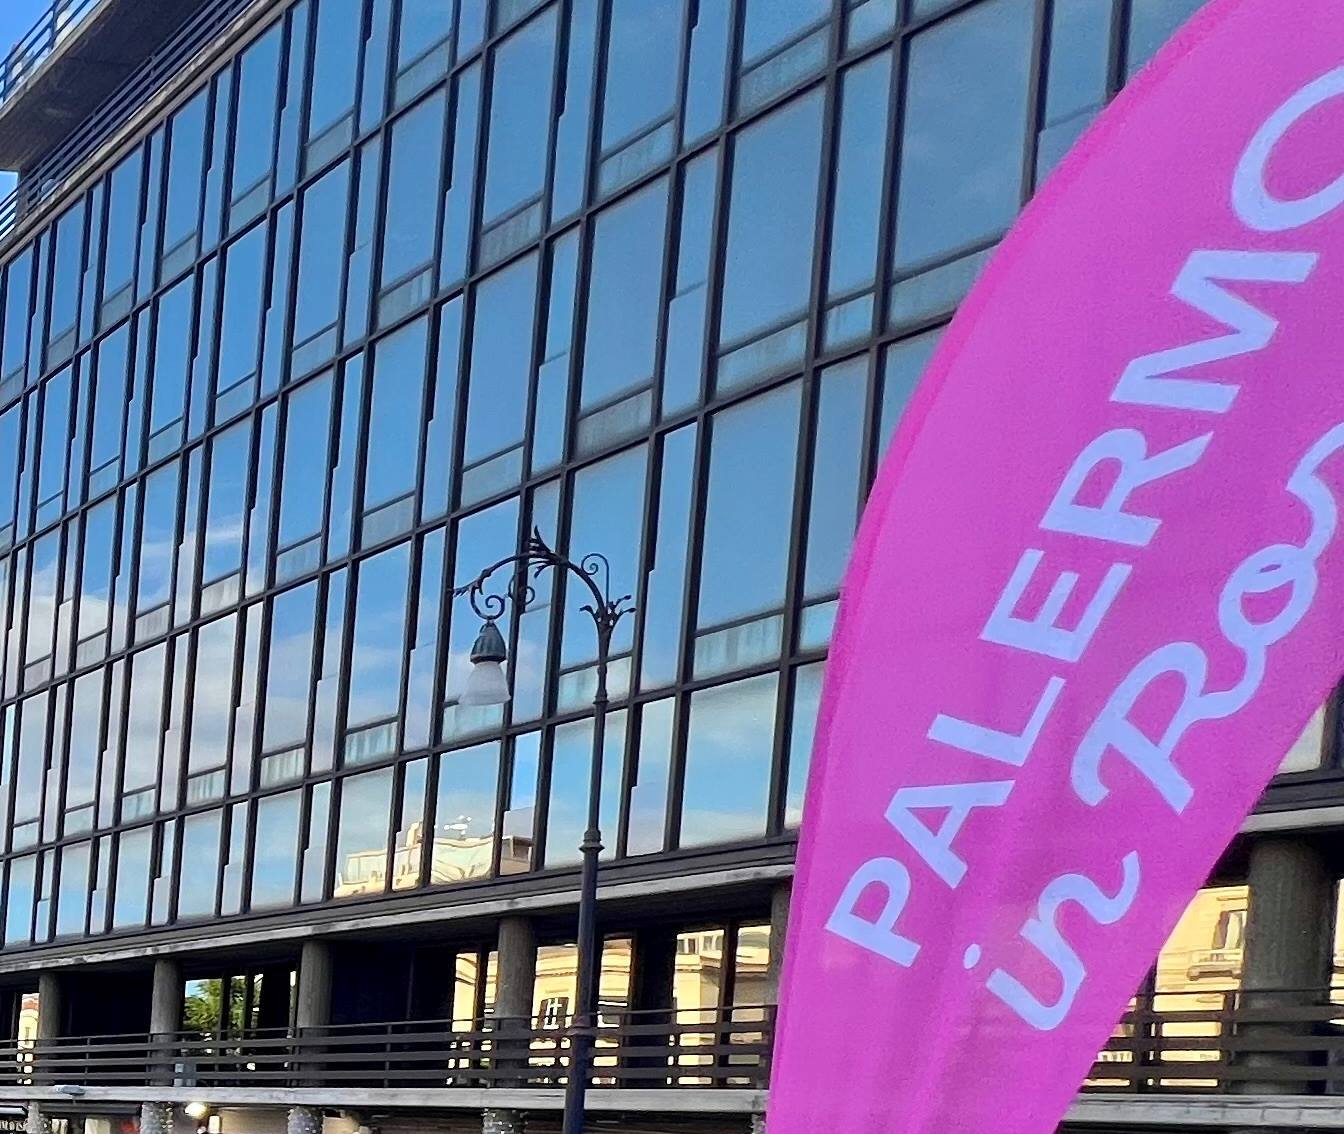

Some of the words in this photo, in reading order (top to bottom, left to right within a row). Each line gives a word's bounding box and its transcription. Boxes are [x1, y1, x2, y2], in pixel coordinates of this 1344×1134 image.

[825, 64, 1344, 968] PALERMO
[963, 848, 1140, 1032] in
[1071, 422, 1344, 814] Ro
